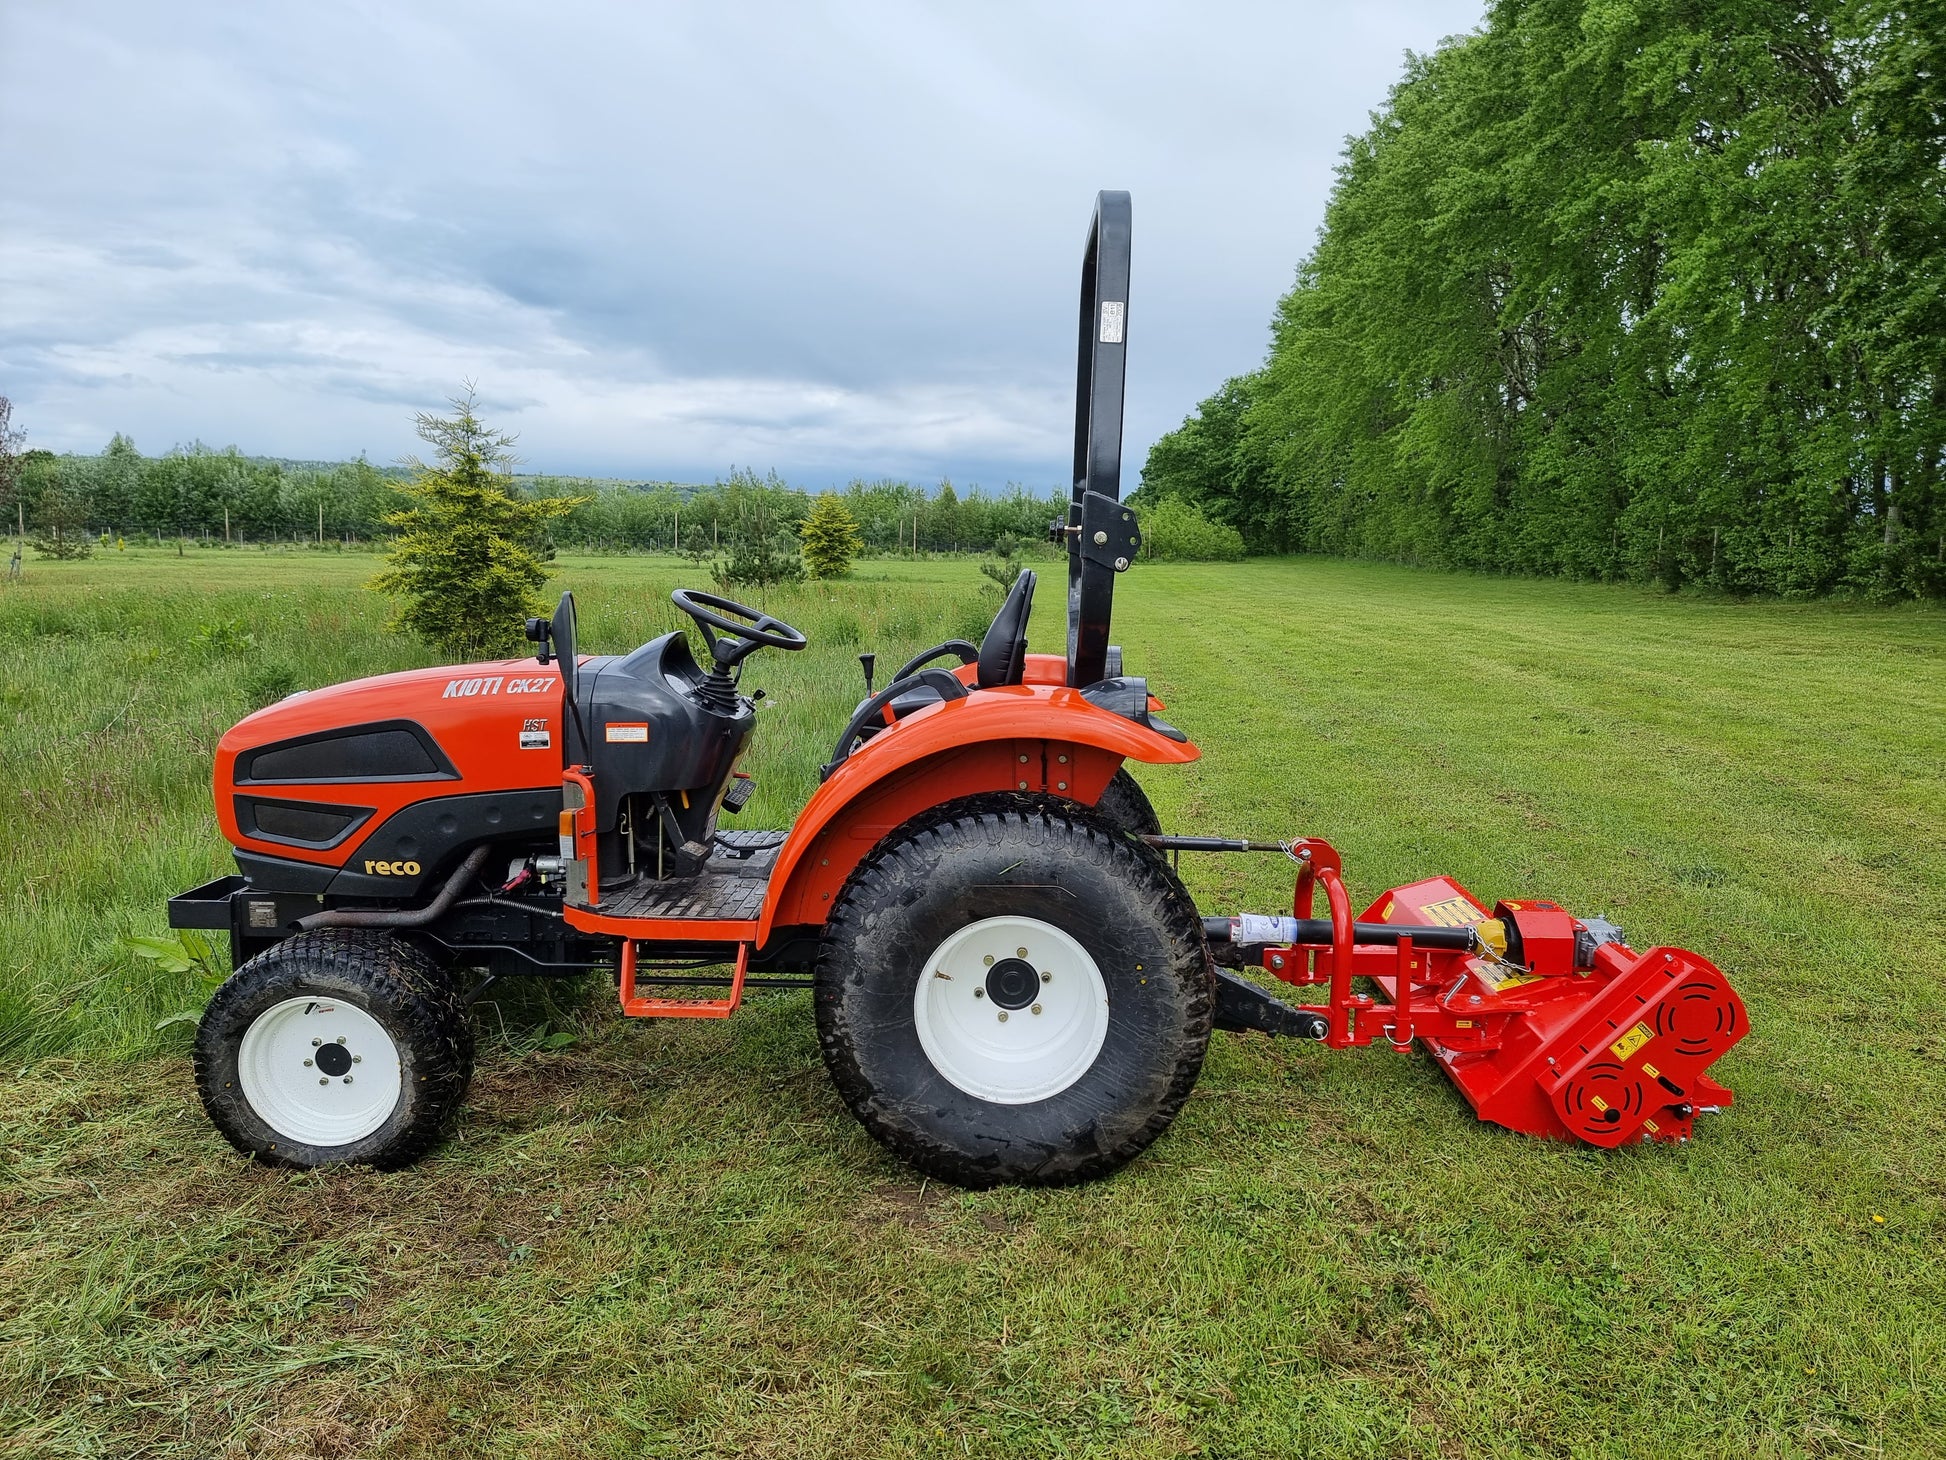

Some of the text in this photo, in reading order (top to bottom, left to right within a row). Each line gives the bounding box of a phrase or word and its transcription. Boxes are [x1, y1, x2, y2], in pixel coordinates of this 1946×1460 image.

[441, 676, 556, 699] KIOTI CK27
[522, 718, 548, 732] HST
[364, 860, 421, 876] reco
